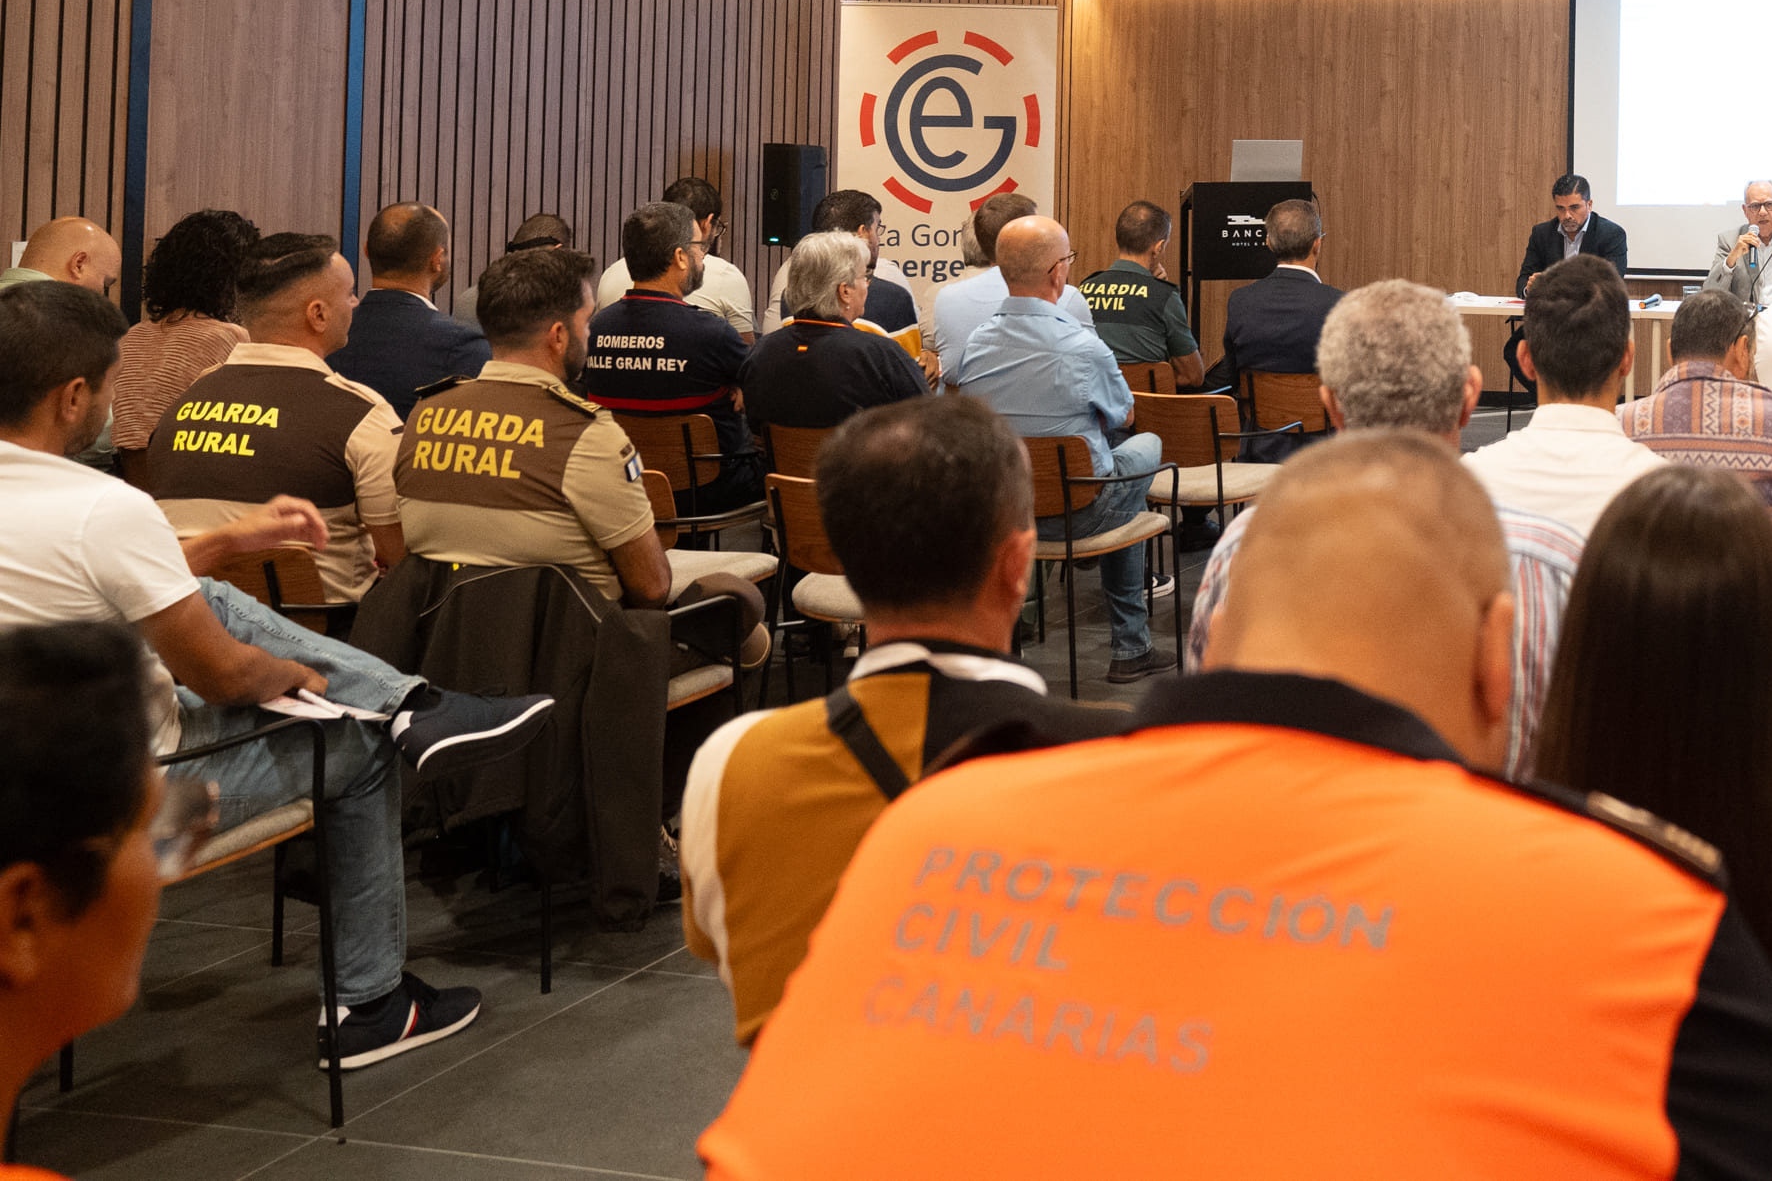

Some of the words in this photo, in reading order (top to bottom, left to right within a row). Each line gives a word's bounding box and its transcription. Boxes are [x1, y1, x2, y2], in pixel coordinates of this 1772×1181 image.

[1221, 229, 1268, 238] BANC
[1086, 296, 1126, 310] CIVIL
[596, 335, 665, 349] BOMBEROS
[615, 357, 652, 371] GRAN
[656, 358, 688, 372] REY
[176, 401, 279, 428] GUARDA
[416, 407, 545, 448] GUARDA
[172, 430, 255, 456] RURAL
[412, 440, 521, 479] RURAL
[895, 903, 1067, 970] CIVIL
[864, 976, 1213, 1073] CANARIAS
